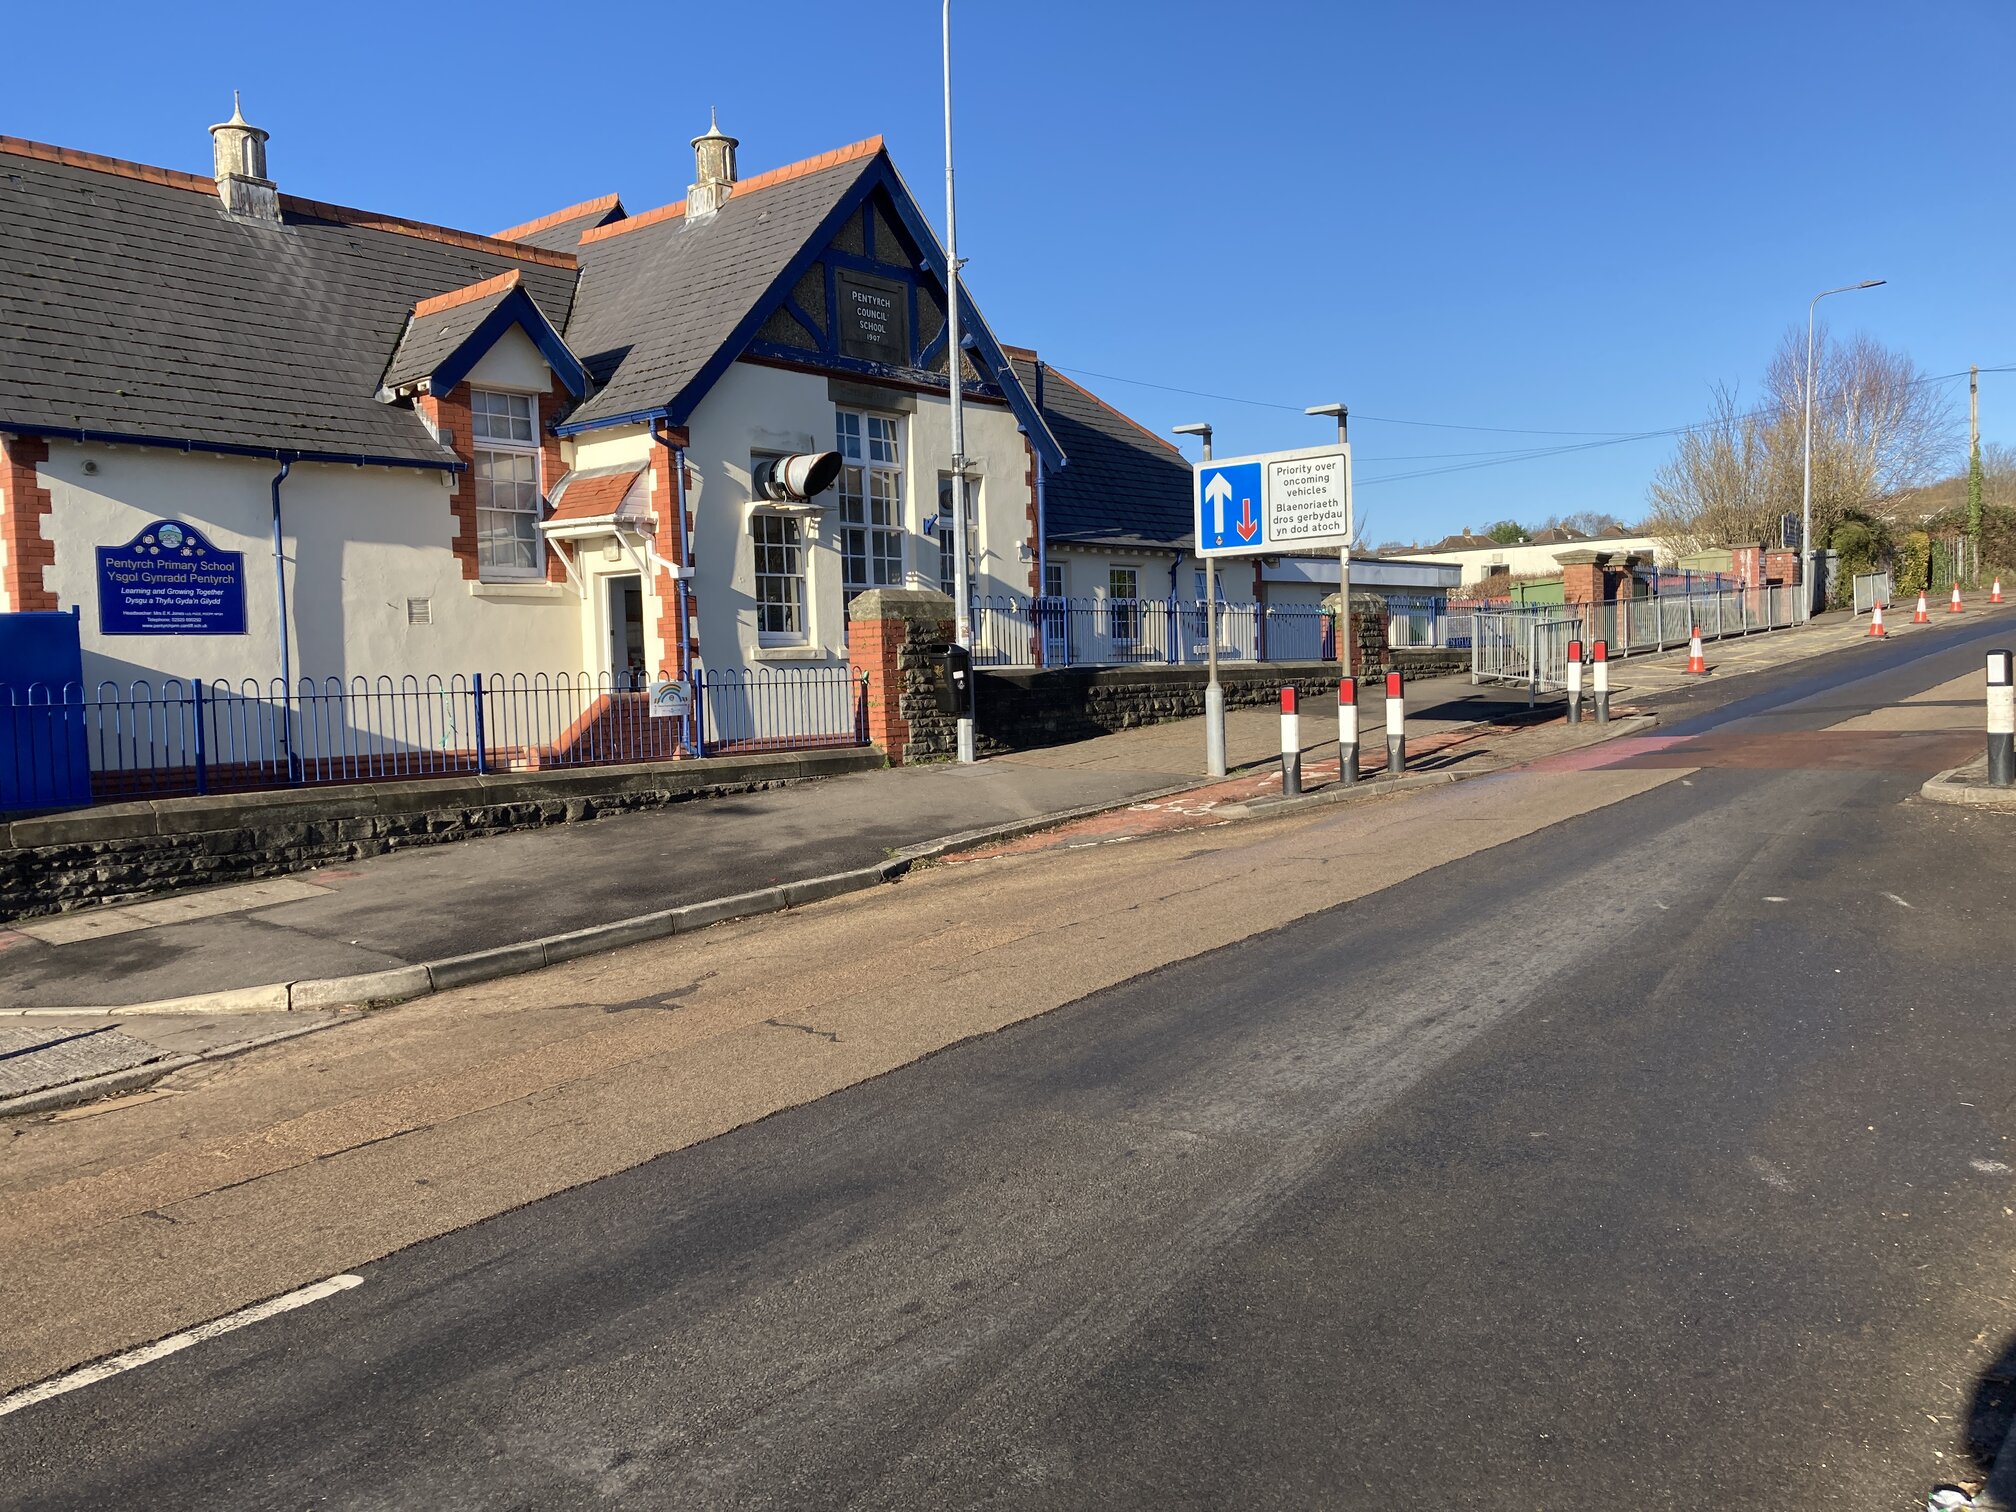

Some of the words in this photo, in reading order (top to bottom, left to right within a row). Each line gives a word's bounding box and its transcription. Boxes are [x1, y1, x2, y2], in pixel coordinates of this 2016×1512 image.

[852, 291, 890, 308] PENTYRCH
[857, 307, 887, 321] COUNCIL
[860, 320, 886, 333] SCHOOL
[866, 333, 880, 342] 1907
[1277, 464, 1312, 476] Priority
[1315, 462, 1336, 471] over
[1283, 474, 1330, 486] oncoming
[1287, 485, 1327, 497] vehicles
[1276, 498, 1338, 512] Blaenoriaeth
[1273, 515, 1294, 525] dros
[1297, 510, 1342, 523] gerbydau
[1276, 527, 1287, 536] yn
[1290, 524, 1309, 534] dod
[1312, 521, 1340, 532] atoch
[105, 557, 154, 571] Pentyrch
[157, 559, 197, 572] Primary
[200, 561, 235, 571] School
[107, 571, 139, 583] Ysgol
[141, 572, 187, 584] Gynradd
[190, 573, 235, 586] Pentyrch
[121, 587, 151, 596] Learning
[167, 588, 194, 596] Growing
[196, 588, 224, 596] Together
[125, 596, 148, 605] Dysgu
[155, 597, 174, 605] Thyfu
